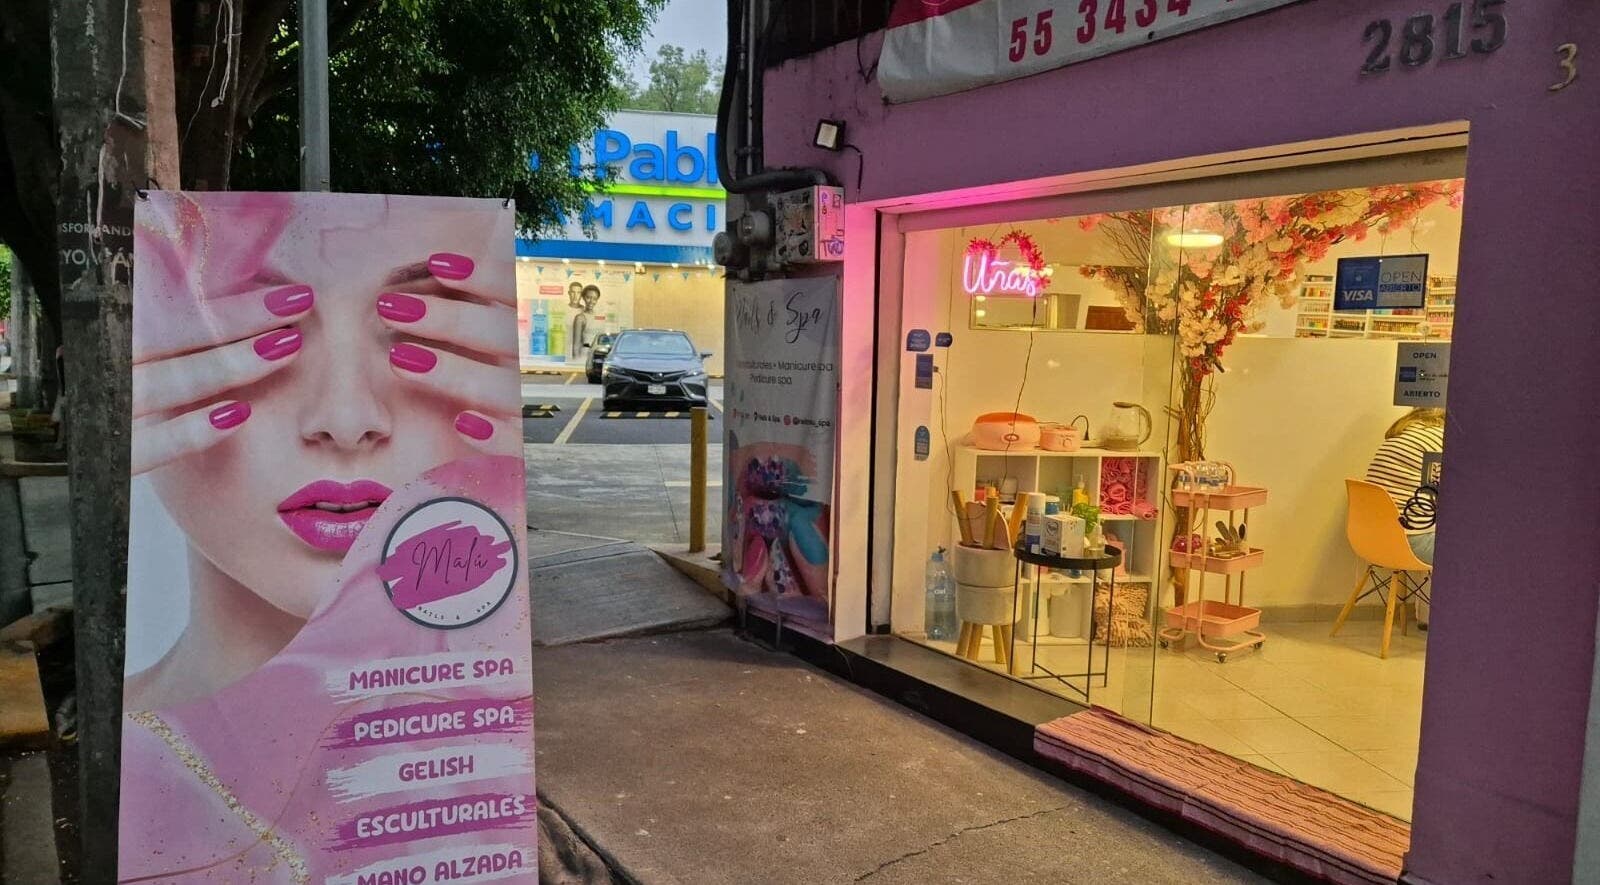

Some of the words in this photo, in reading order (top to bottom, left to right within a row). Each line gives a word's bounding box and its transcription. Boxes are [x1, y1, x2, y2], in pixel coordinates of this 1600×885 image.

[1008, 9, 1054, 62] 55
[1360, 0, 1507, 75] 2815
[1548, 43, 1577, 91] 3
[594, 129, 718, 184] Pabl
[963, 252, 1036, 297] Uñas
[1342, 289, 1374, 301] VISA
[1381, 271, 1422, 283] OPEN
[785, 291, 822, 344] Spa
[1403, 390, 1441, 398] ABIERTO
[411, 536, 489, 592] Malú
[348, 662, 466, 691] MANICURE
[472, 657, 514, 679] SPA
[354, 710, 466, 741] PEDICURE
[472, 705, 515, 728] SPA
[398, 754, 474, 782] GELISH
[356, 794, 526, 838] ESCULTURALES
[357, 865, 427, 885] MANO
[434, 850, 522, 882] ALZADA
